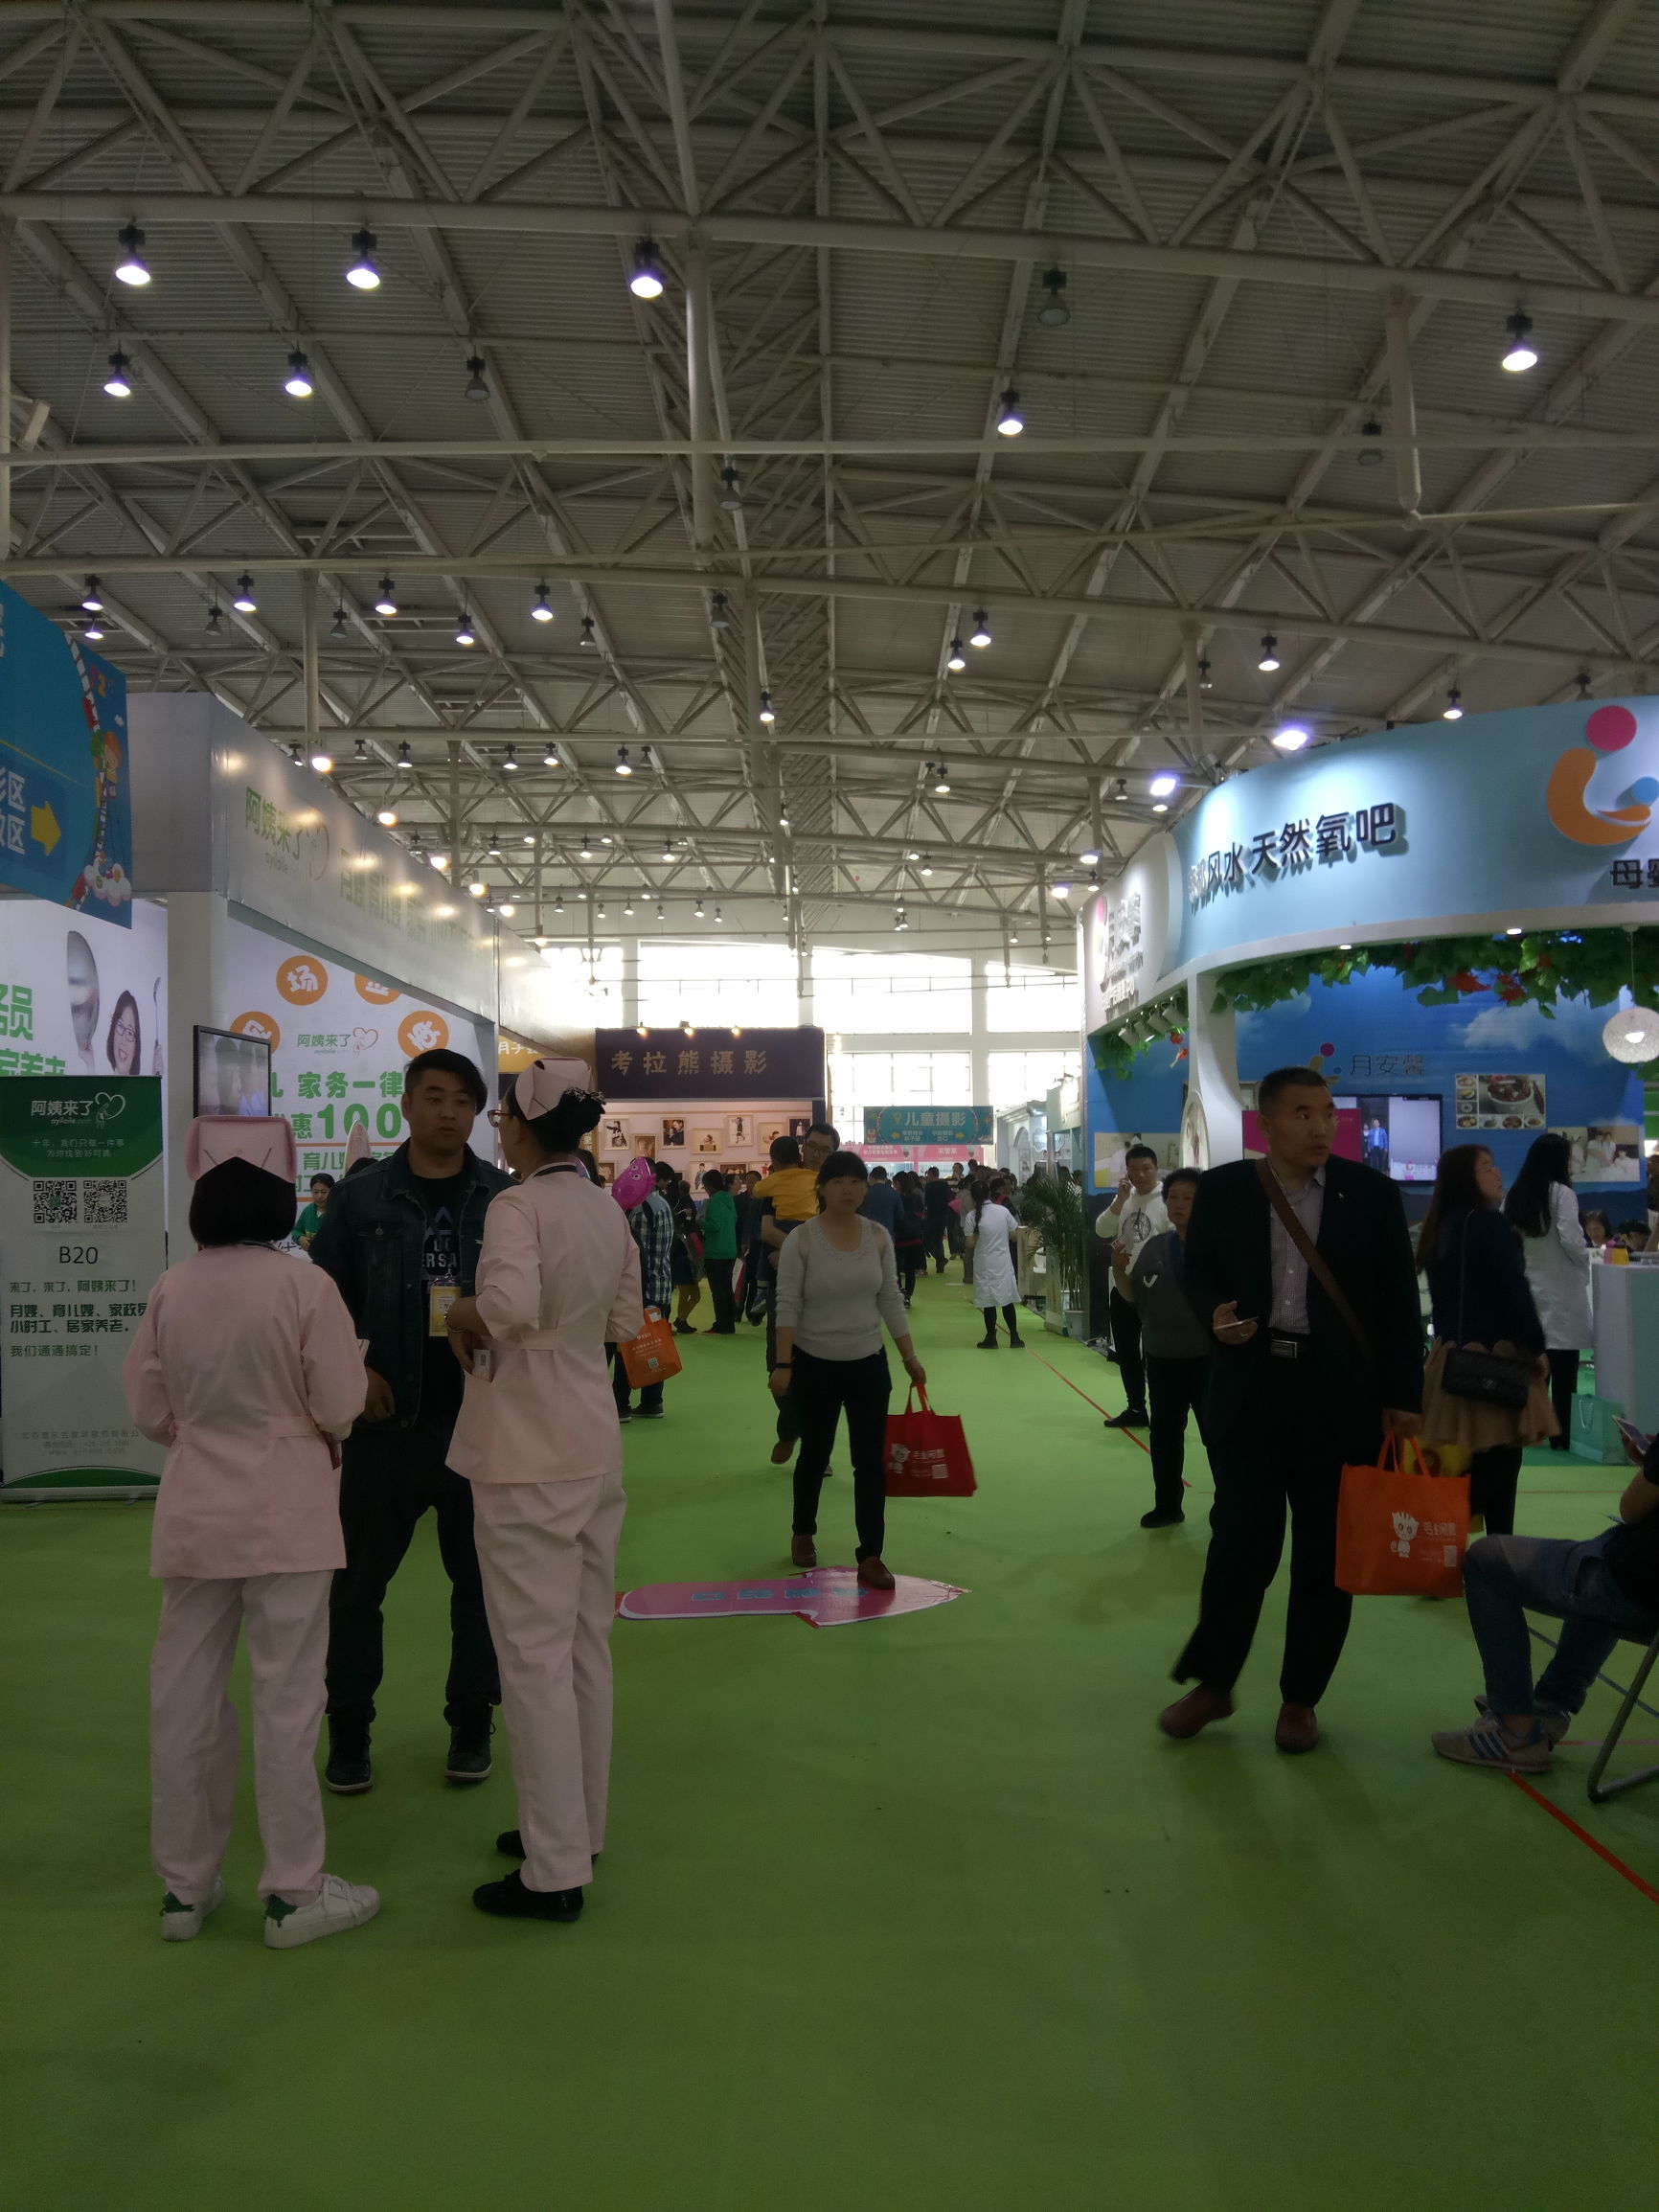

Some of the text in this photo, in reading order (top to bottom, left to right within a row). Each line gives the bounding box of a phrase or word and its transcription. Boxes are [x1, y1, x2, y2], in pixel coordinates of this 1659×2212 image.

[0, 814, 26, 855] 区
[286, 965, 318, 992] 场
[297, 1033, 352, 1048] 阿姨来了
[611, 1049, 767, 1076] 考拉熊摄影
[298, 1070, 403, 1099] 家务一律
[31, 1100, 94, 1117] 阿姨来了
[904, 1111, 966, 1128] 儿童摄影
[59, 1245, 99, 1265] B20
